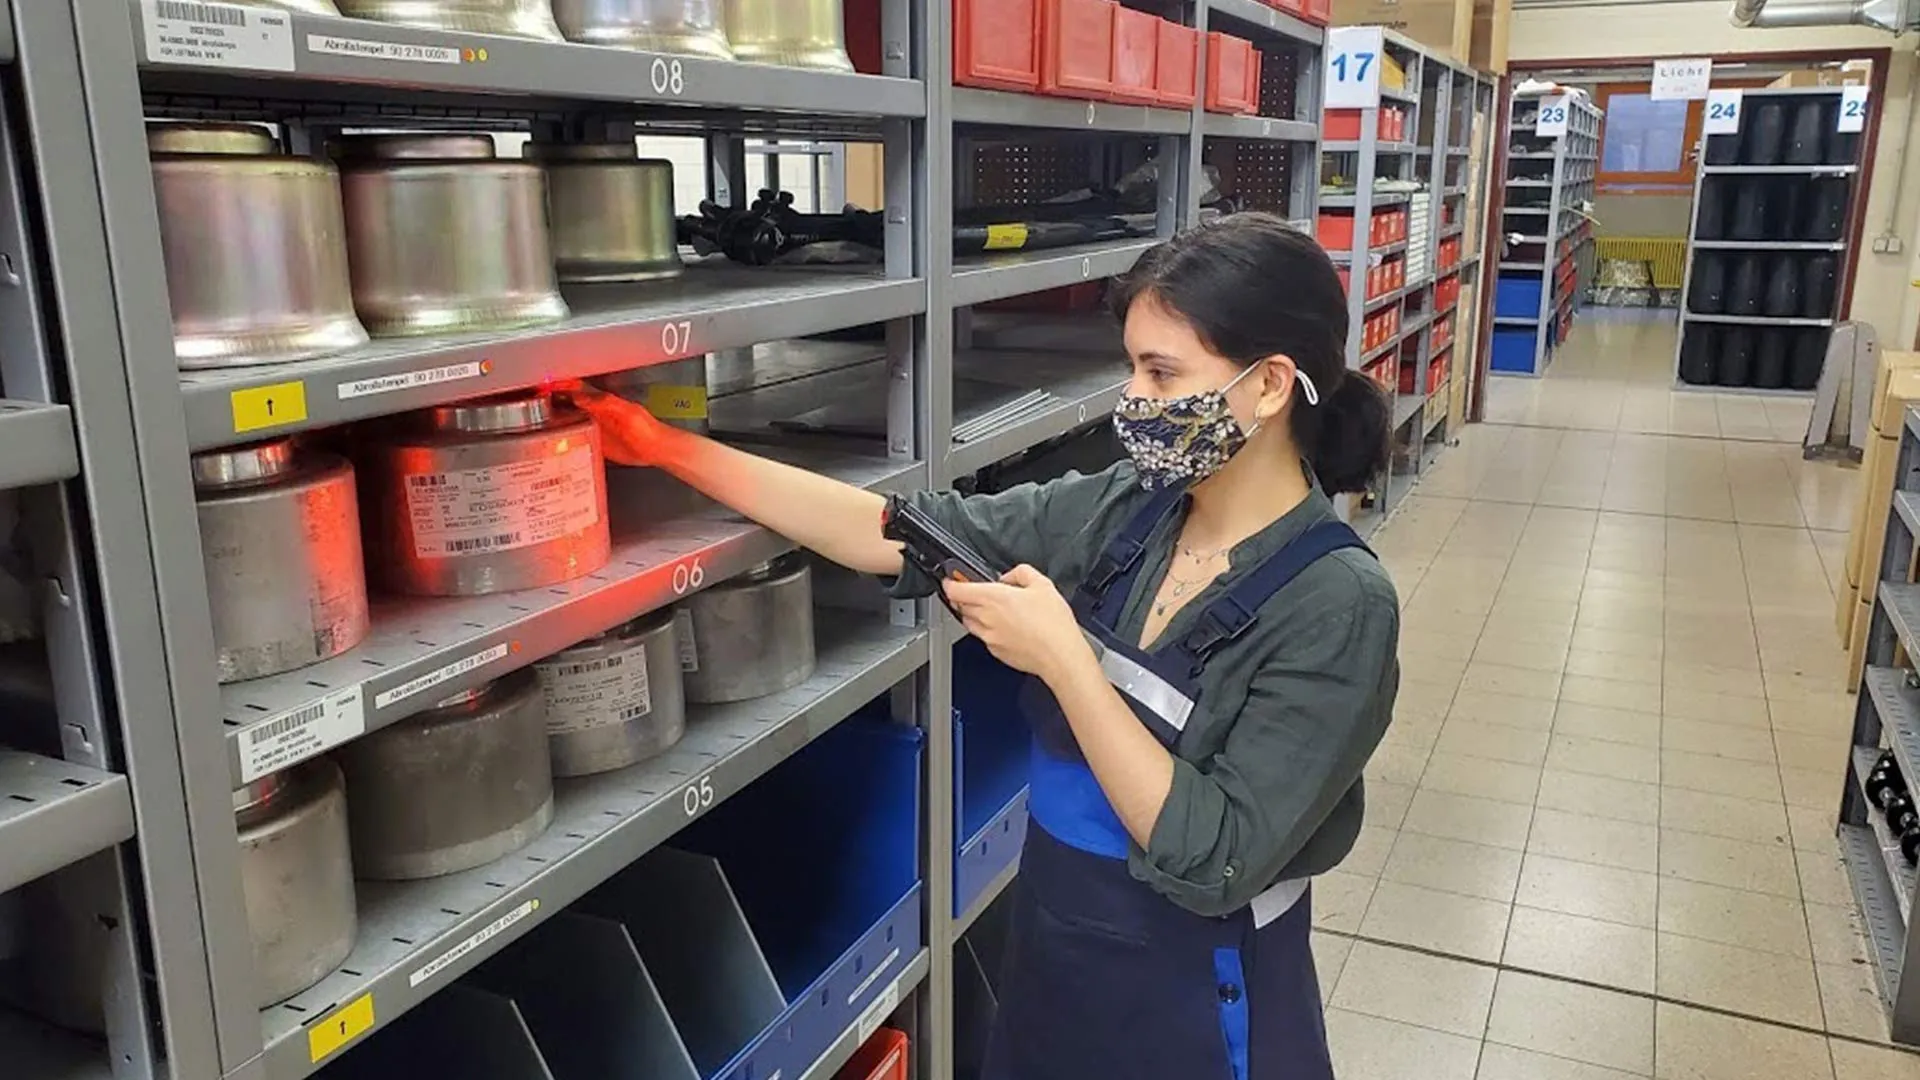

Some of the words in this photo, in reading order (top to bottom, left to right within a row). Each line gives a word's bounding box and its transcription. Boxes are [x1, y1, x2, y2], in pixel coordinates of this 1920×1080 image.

[651, 58, 683, 94] 08
[1332, 53, 1374, 82] 17
[1542, 107, 1564, 123] 23
[1710, 103, 1735, 119] 24
[662, 321, 691, 356] 07
[672, 557, 704, 594] 06
[684, 775, 714, 817] 05
